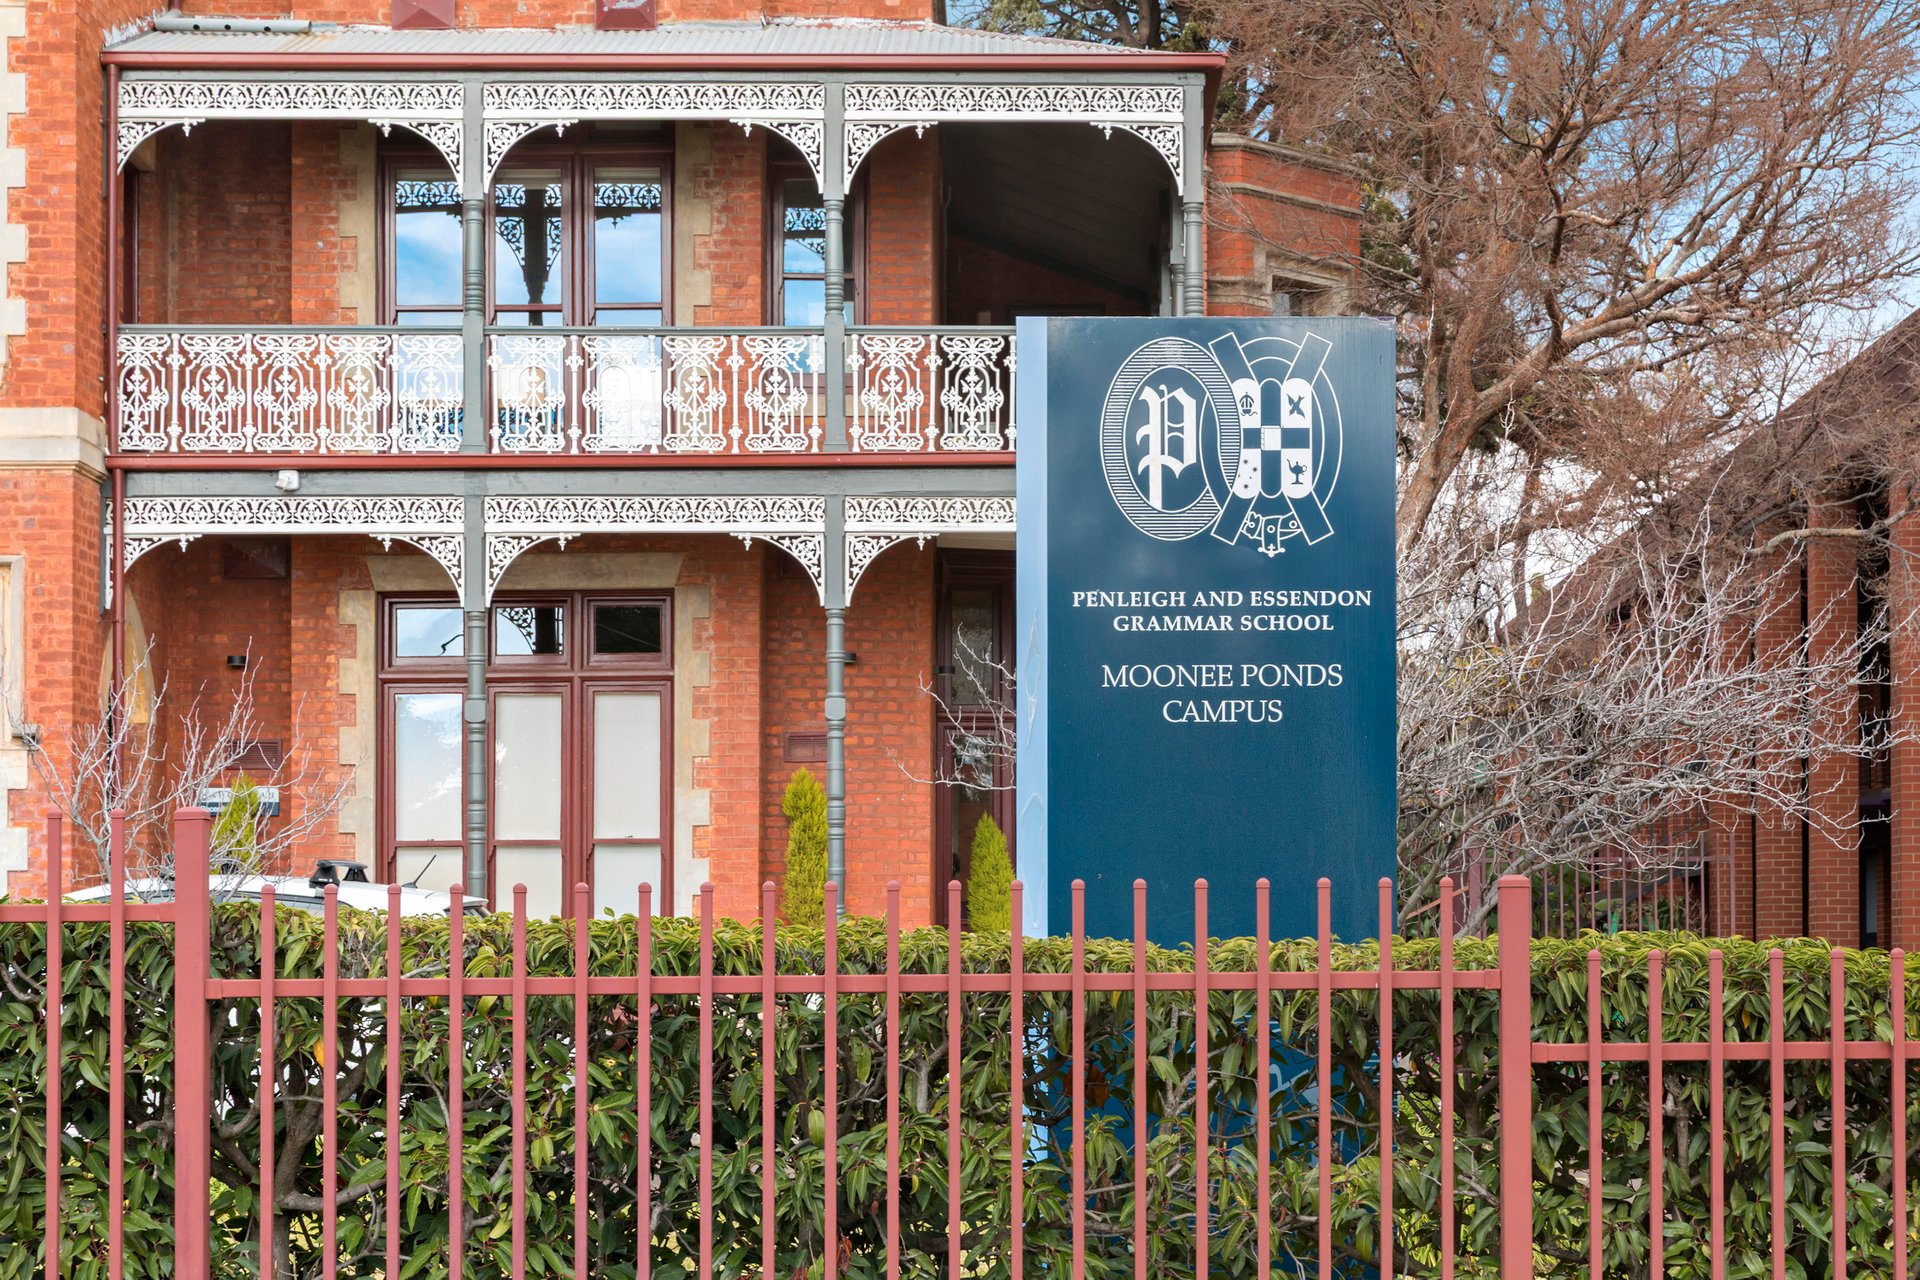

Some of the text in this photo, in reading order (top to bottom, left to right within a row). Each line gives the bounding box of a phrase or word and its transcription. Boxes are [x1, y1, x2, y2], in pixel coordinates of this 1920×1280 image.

[1072, 590, 1372, 608] PENLEIGH AND ESSENDON
[1112, 614, 1335, 632] GRAMMAR SCHOOL
[1101, 663, 1343, 688] MOONEE PONDS
[1162, 700, 1283, 723] CAMPUS
